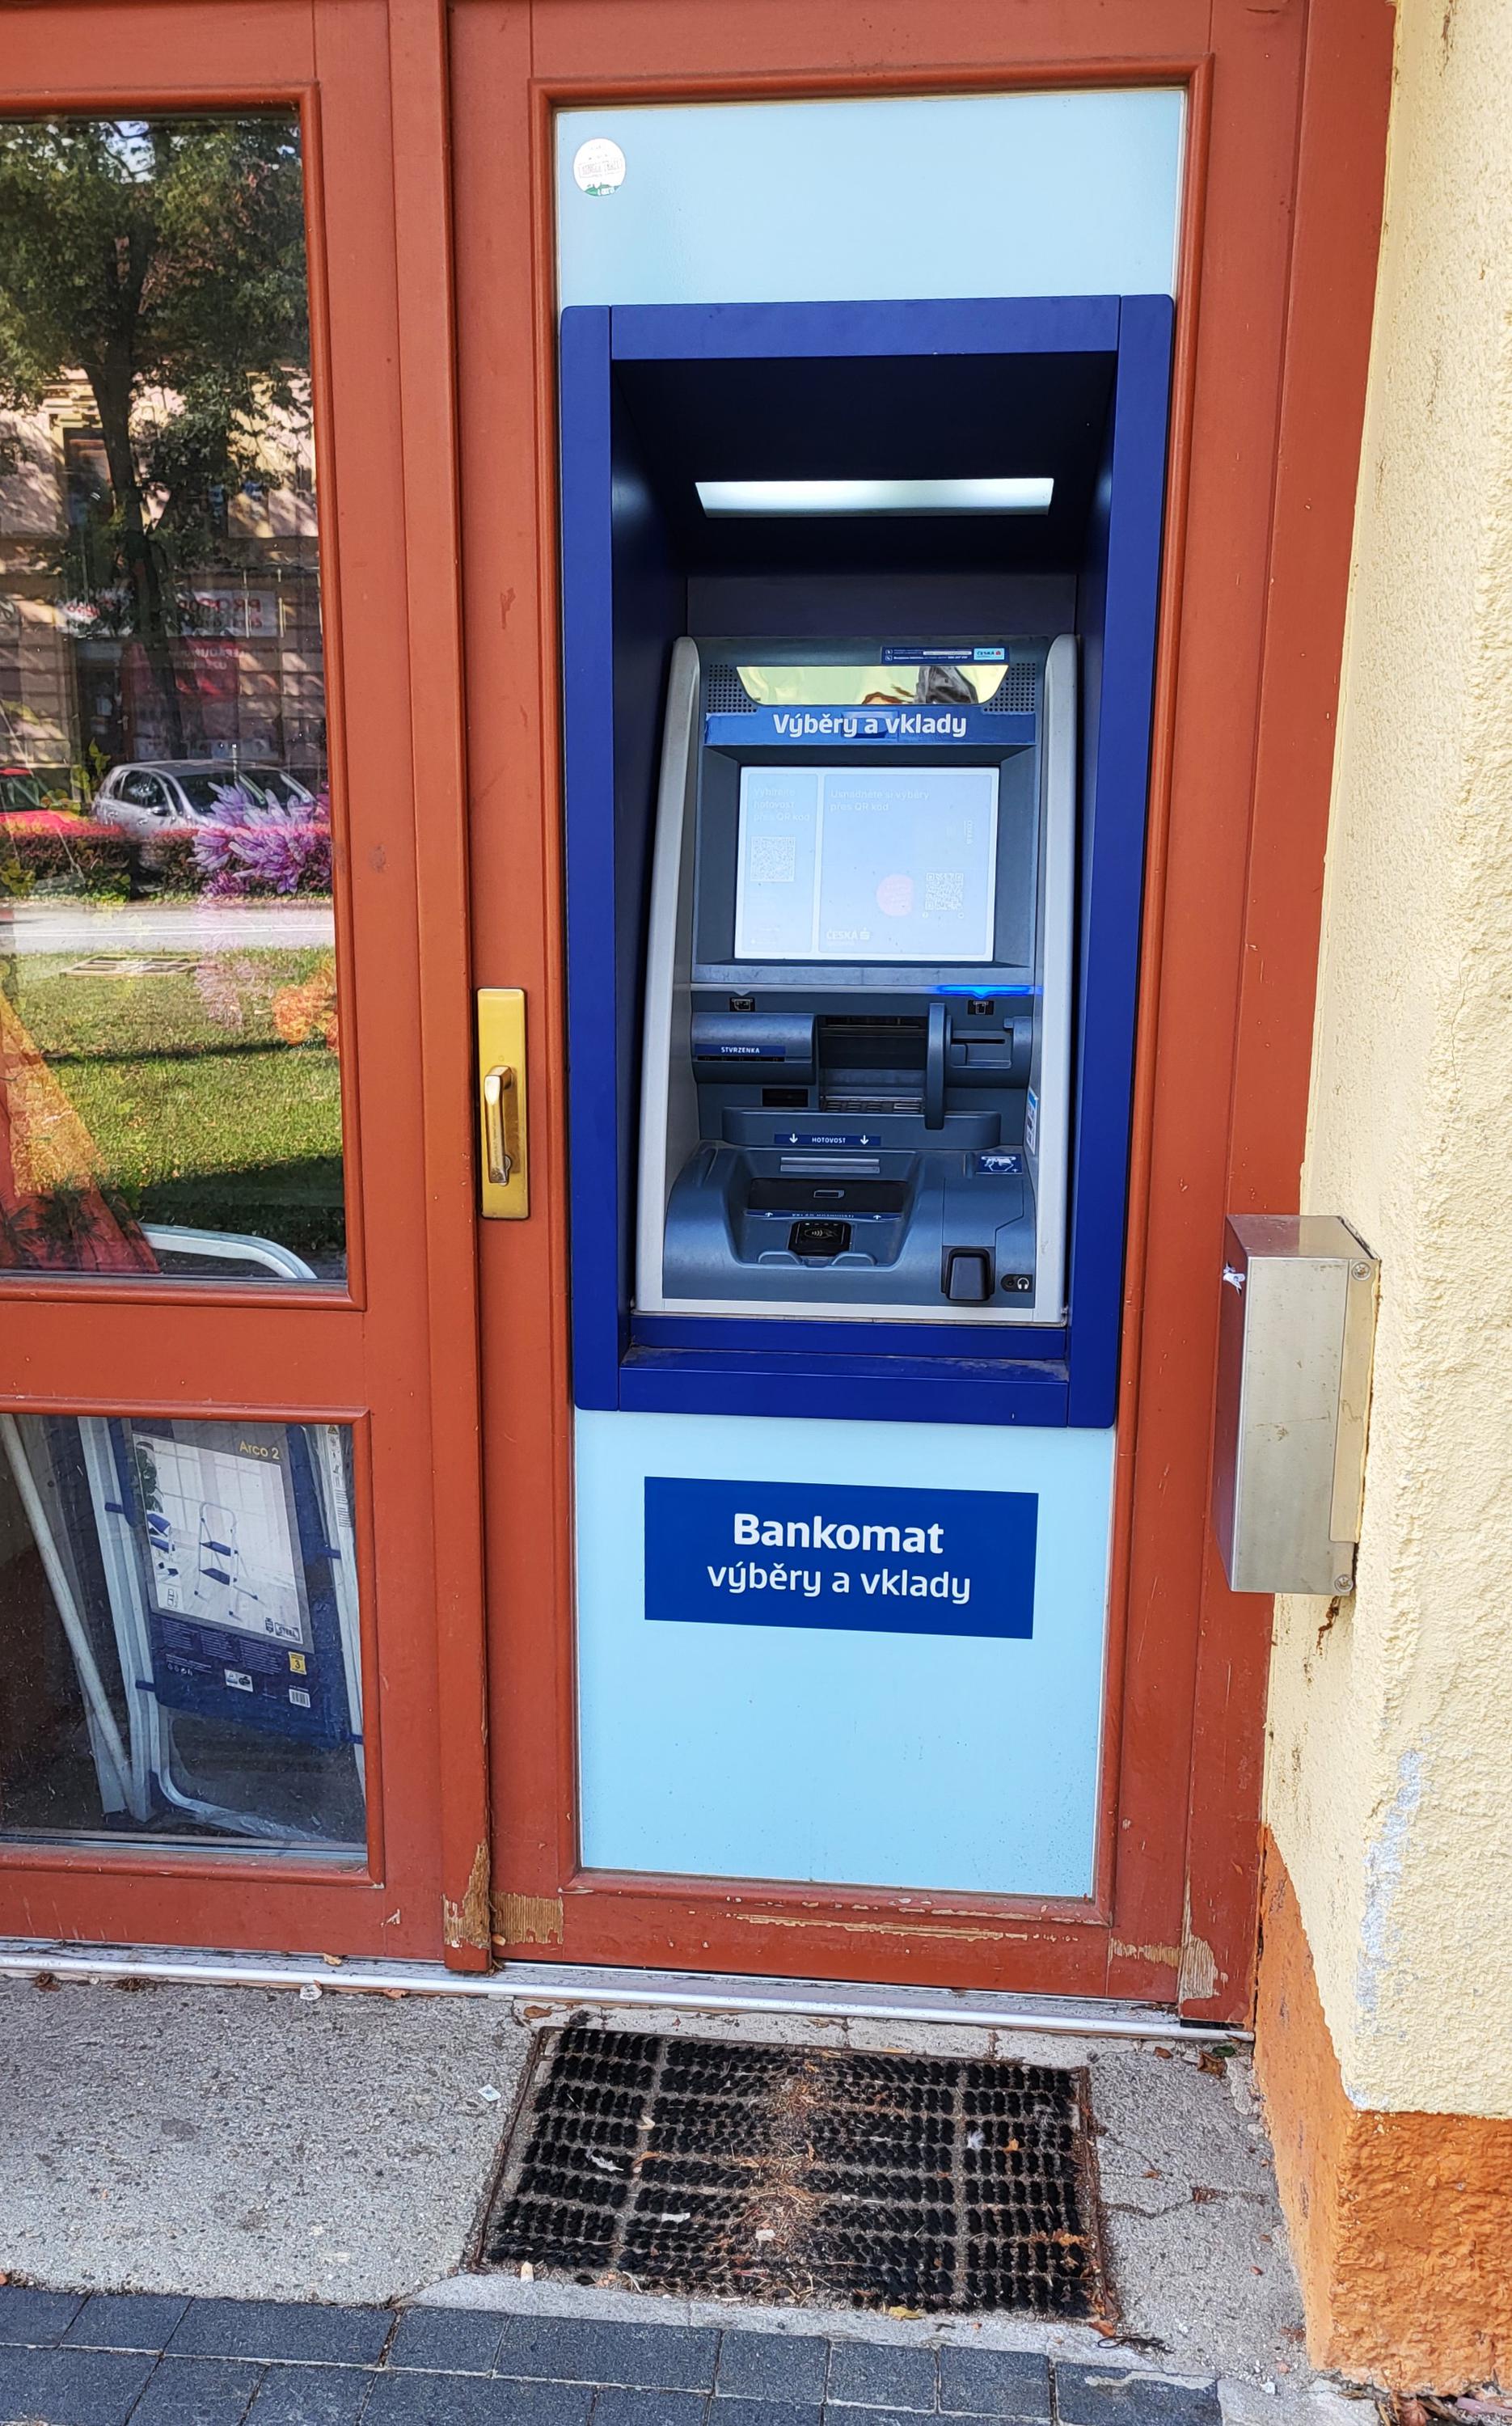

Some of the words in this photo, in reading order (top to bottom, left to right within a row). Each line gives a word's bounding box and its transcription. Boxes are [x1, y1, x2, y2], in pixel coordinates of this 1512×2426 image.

[773, 713, 857, 738] Výběry
[864, 717, 878, 733] a
[885, 713, 968, 738] vklady
[812, 1136, 846, 1144] HOTOVOST
[239, 1440, 268, 1457] Arco
[271, 1447, 280, 1460] 2
[733, 1512, 944, 1554] Bankomat
[707, 1561, 821, 1597] výběry
[831, 1571, 850, 1593] a
[860, 1569, 971, 1605] vklady
[295, 1659, 300, 1669] 3
